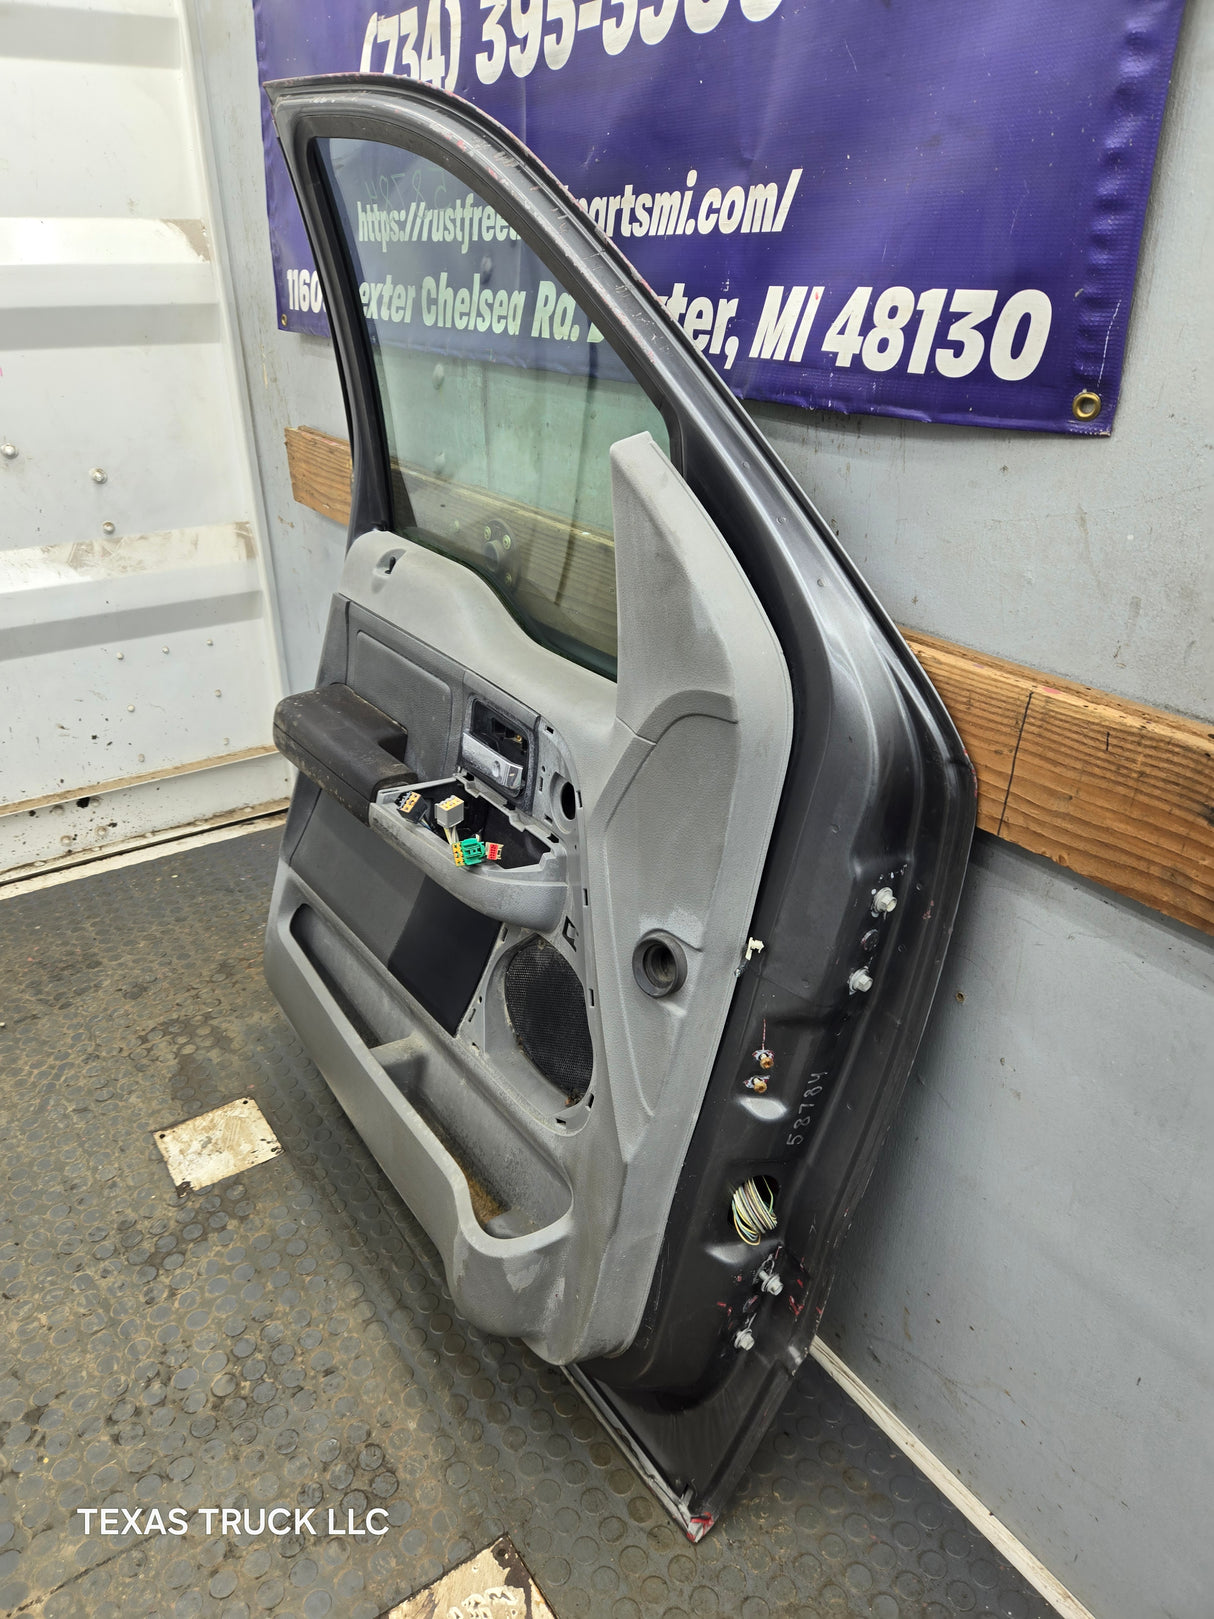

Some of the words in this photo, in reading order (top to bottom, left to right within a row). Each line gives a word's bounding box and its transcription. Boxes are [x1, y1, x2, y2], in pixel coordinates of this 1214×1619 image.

[360, 0, 461, 92] (734)
[287, 269, 327, 314] 1160
[421, 272, 526, 336] Chelsea
[749, 286, 824, 363] MI
[821, 286, 1052, 381] 48130
[786, 1071, 828, 1146] 58784
